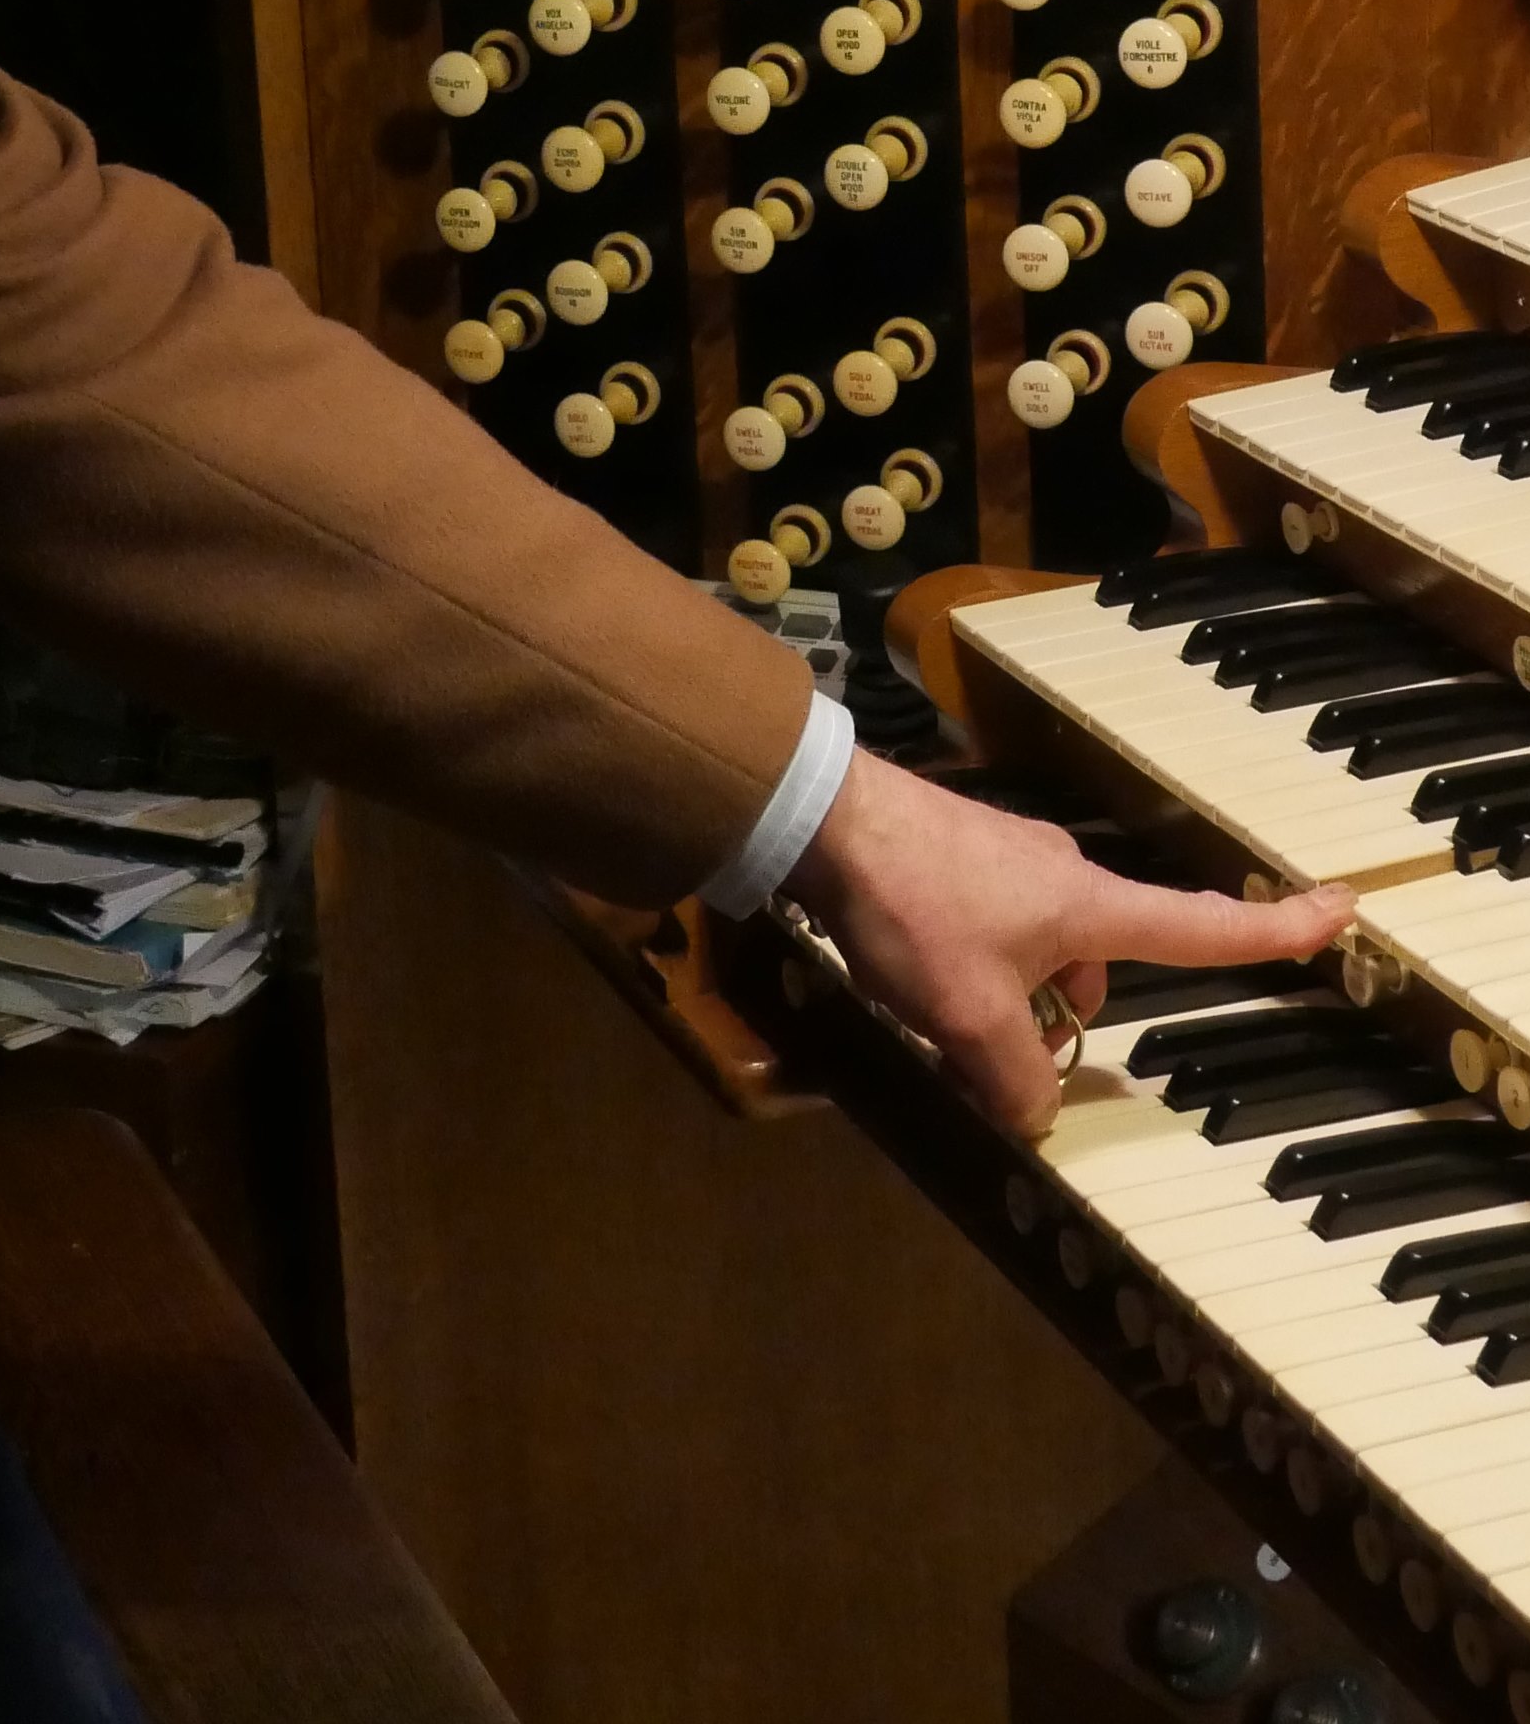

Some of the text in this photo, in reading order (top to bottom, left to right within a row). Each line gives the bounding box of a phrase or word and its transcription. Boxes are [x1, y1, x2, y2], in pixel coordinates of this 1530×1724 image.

[836, 29, 859, 39] OPEN
[836, 40, 860, 51] WOOD
[1135, 40, 1161, 51] VIOLE
[1122, 52, 1178, 63] D'ORCHESTRE
[715, 96, 751, 106] VIOLONE
[1012, 99, 1047, 112] CONTRA
[1016, 112, 1042, 124] VIOLA
[835, 159, 867, 172] DOUBLE
[840, 172, 862, 183] OPEN
[840, 183, 864, 193] WOOD
[1137, 191, 1173, 203] OCTAVE
[729, 227, 747, 237] SUB
[719, 239, 758, 250] BOURDON
[1015, 252, 1048, 263] UNISON
[1147, 331, 1166, 341] SUB
[1139, 341, 1174, 352] OCTAVE
[1022, 382, 1051, 392] SWELL
[1026, 404, 1049, 414] SOLO
[855, 507, 881, 516] GREAT
